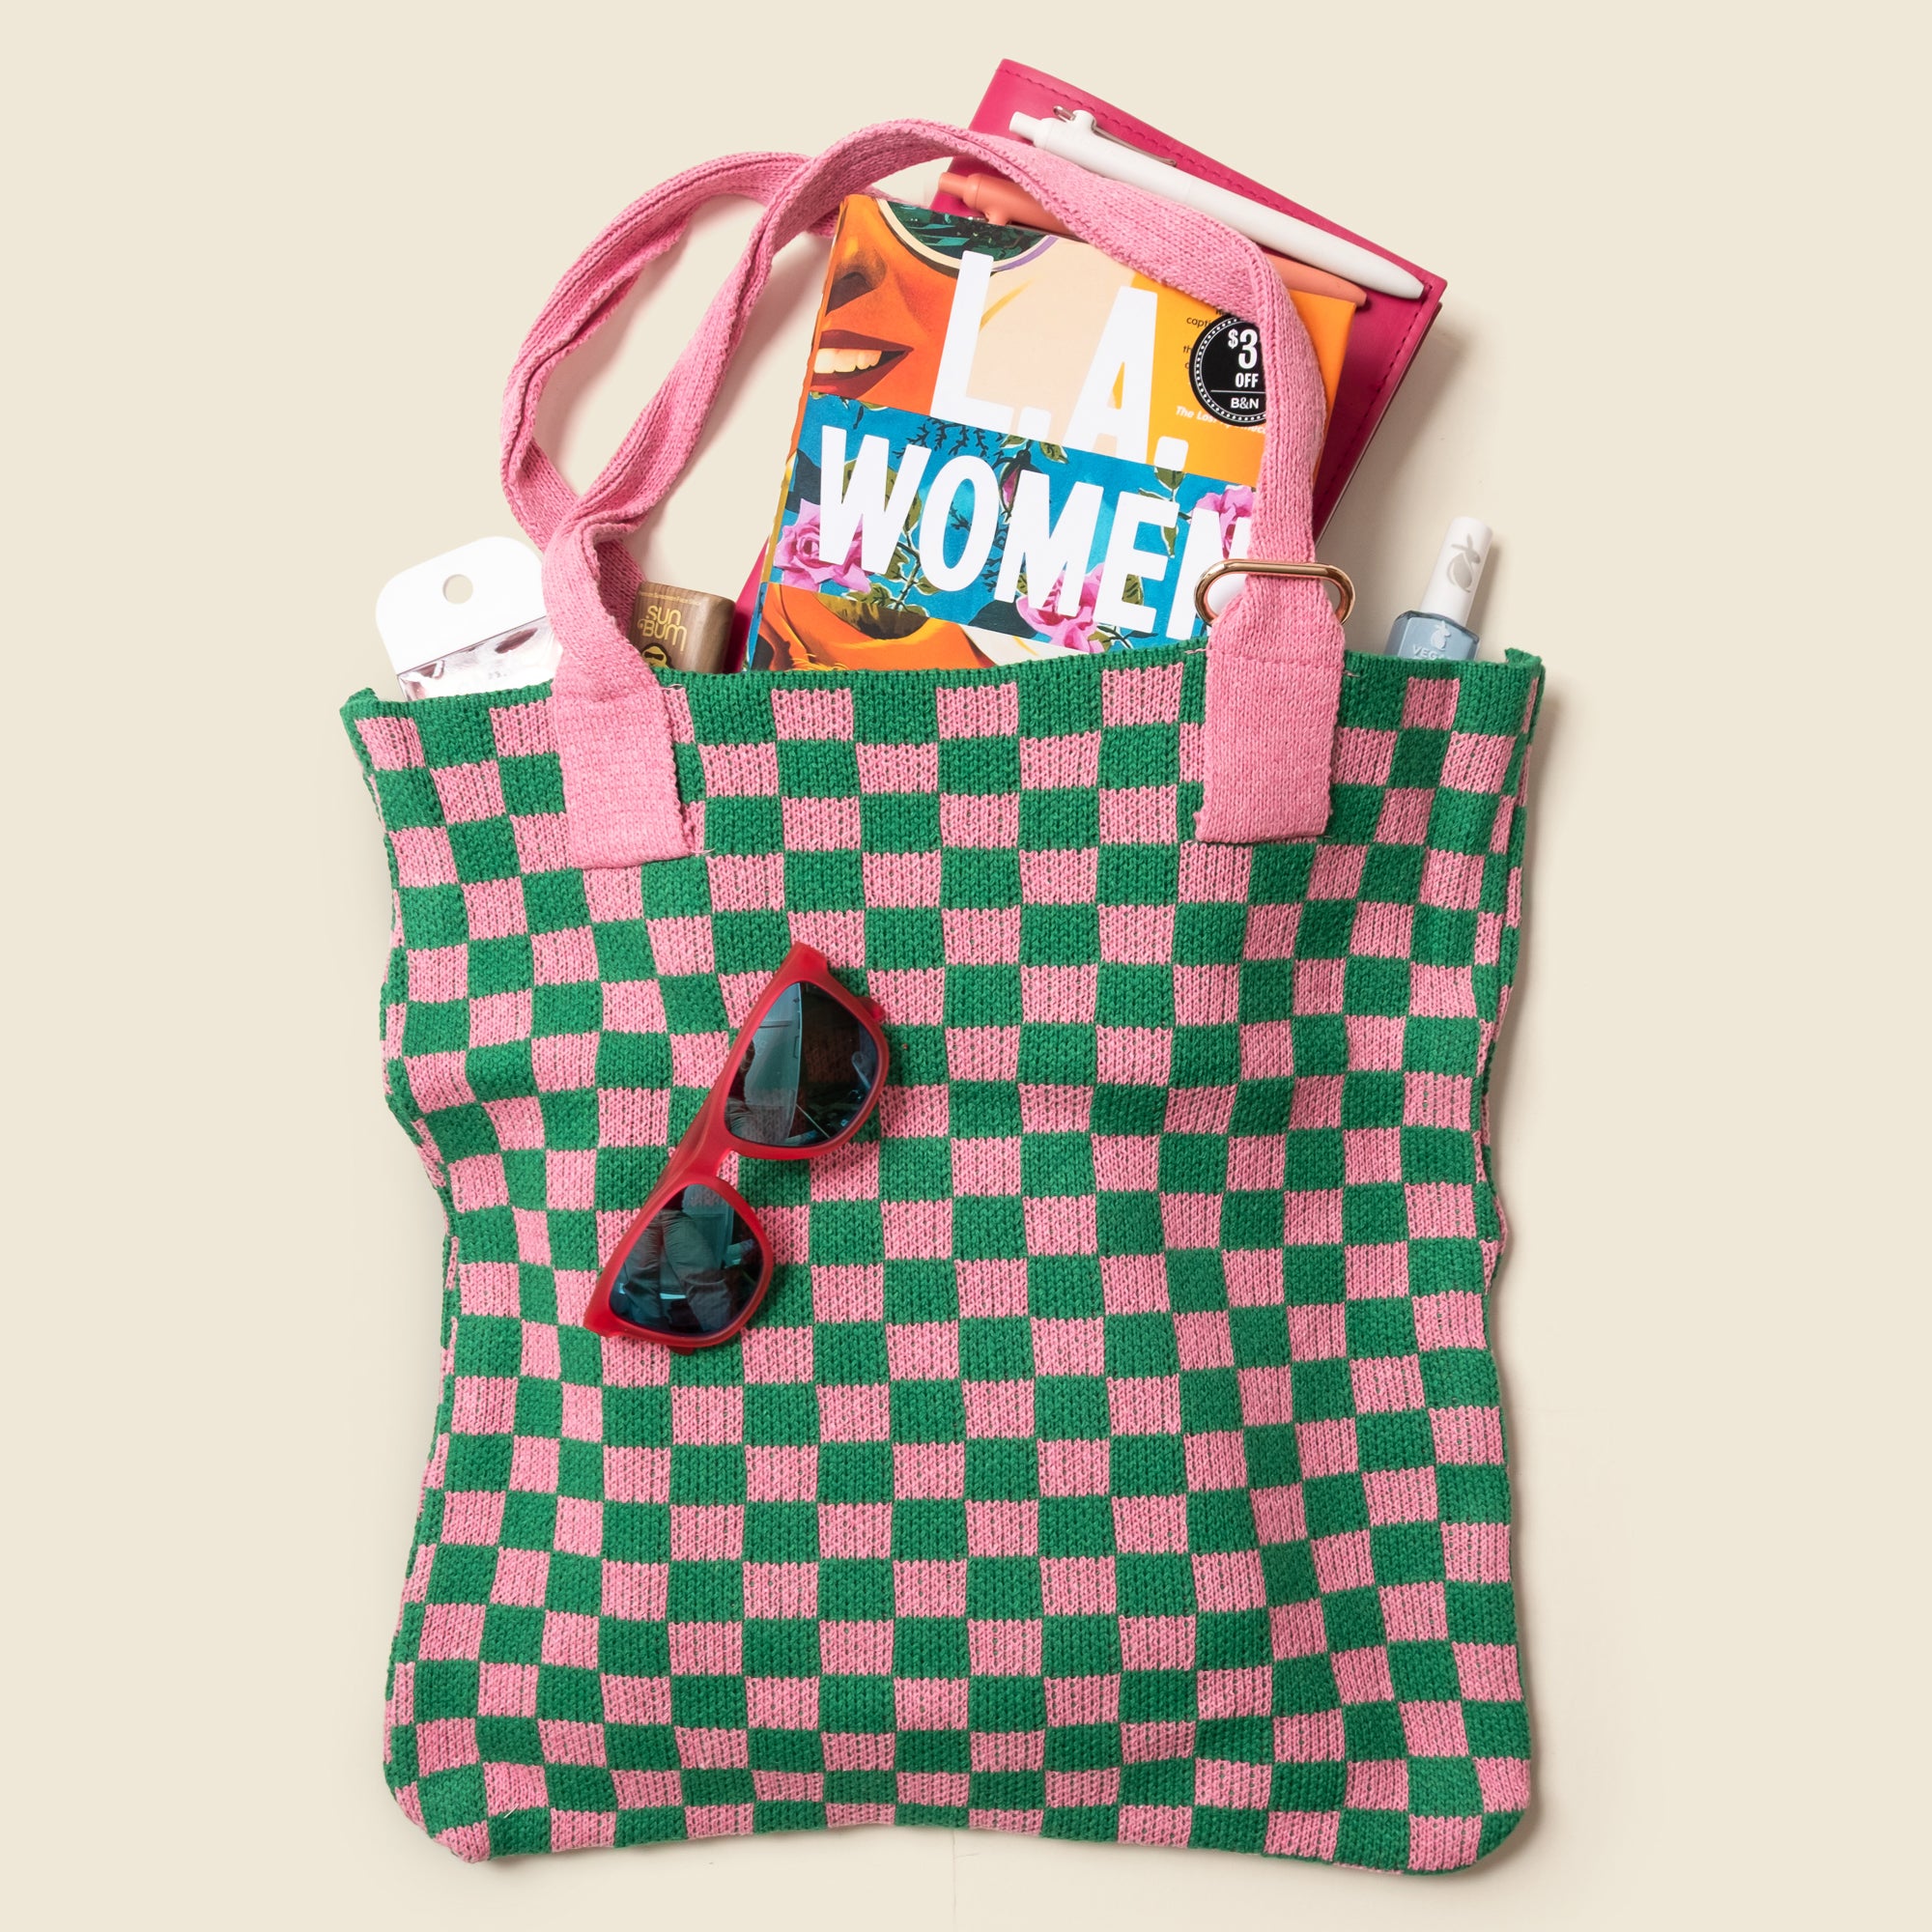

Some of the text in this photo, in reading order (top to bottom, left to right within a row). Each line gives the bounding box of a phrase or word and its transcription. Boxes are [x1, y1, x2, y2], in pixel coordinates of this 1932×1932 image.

[929, 250, 1190, 471] L.A.
[1228, 328, 1259, 369] $3
[1235, 373, 1260, 388] OFF
[1176, 406, 1195, 418] The
[1230, 397, 1260, 410] B&N
[818, 424, 1252, 639] WOMEN
